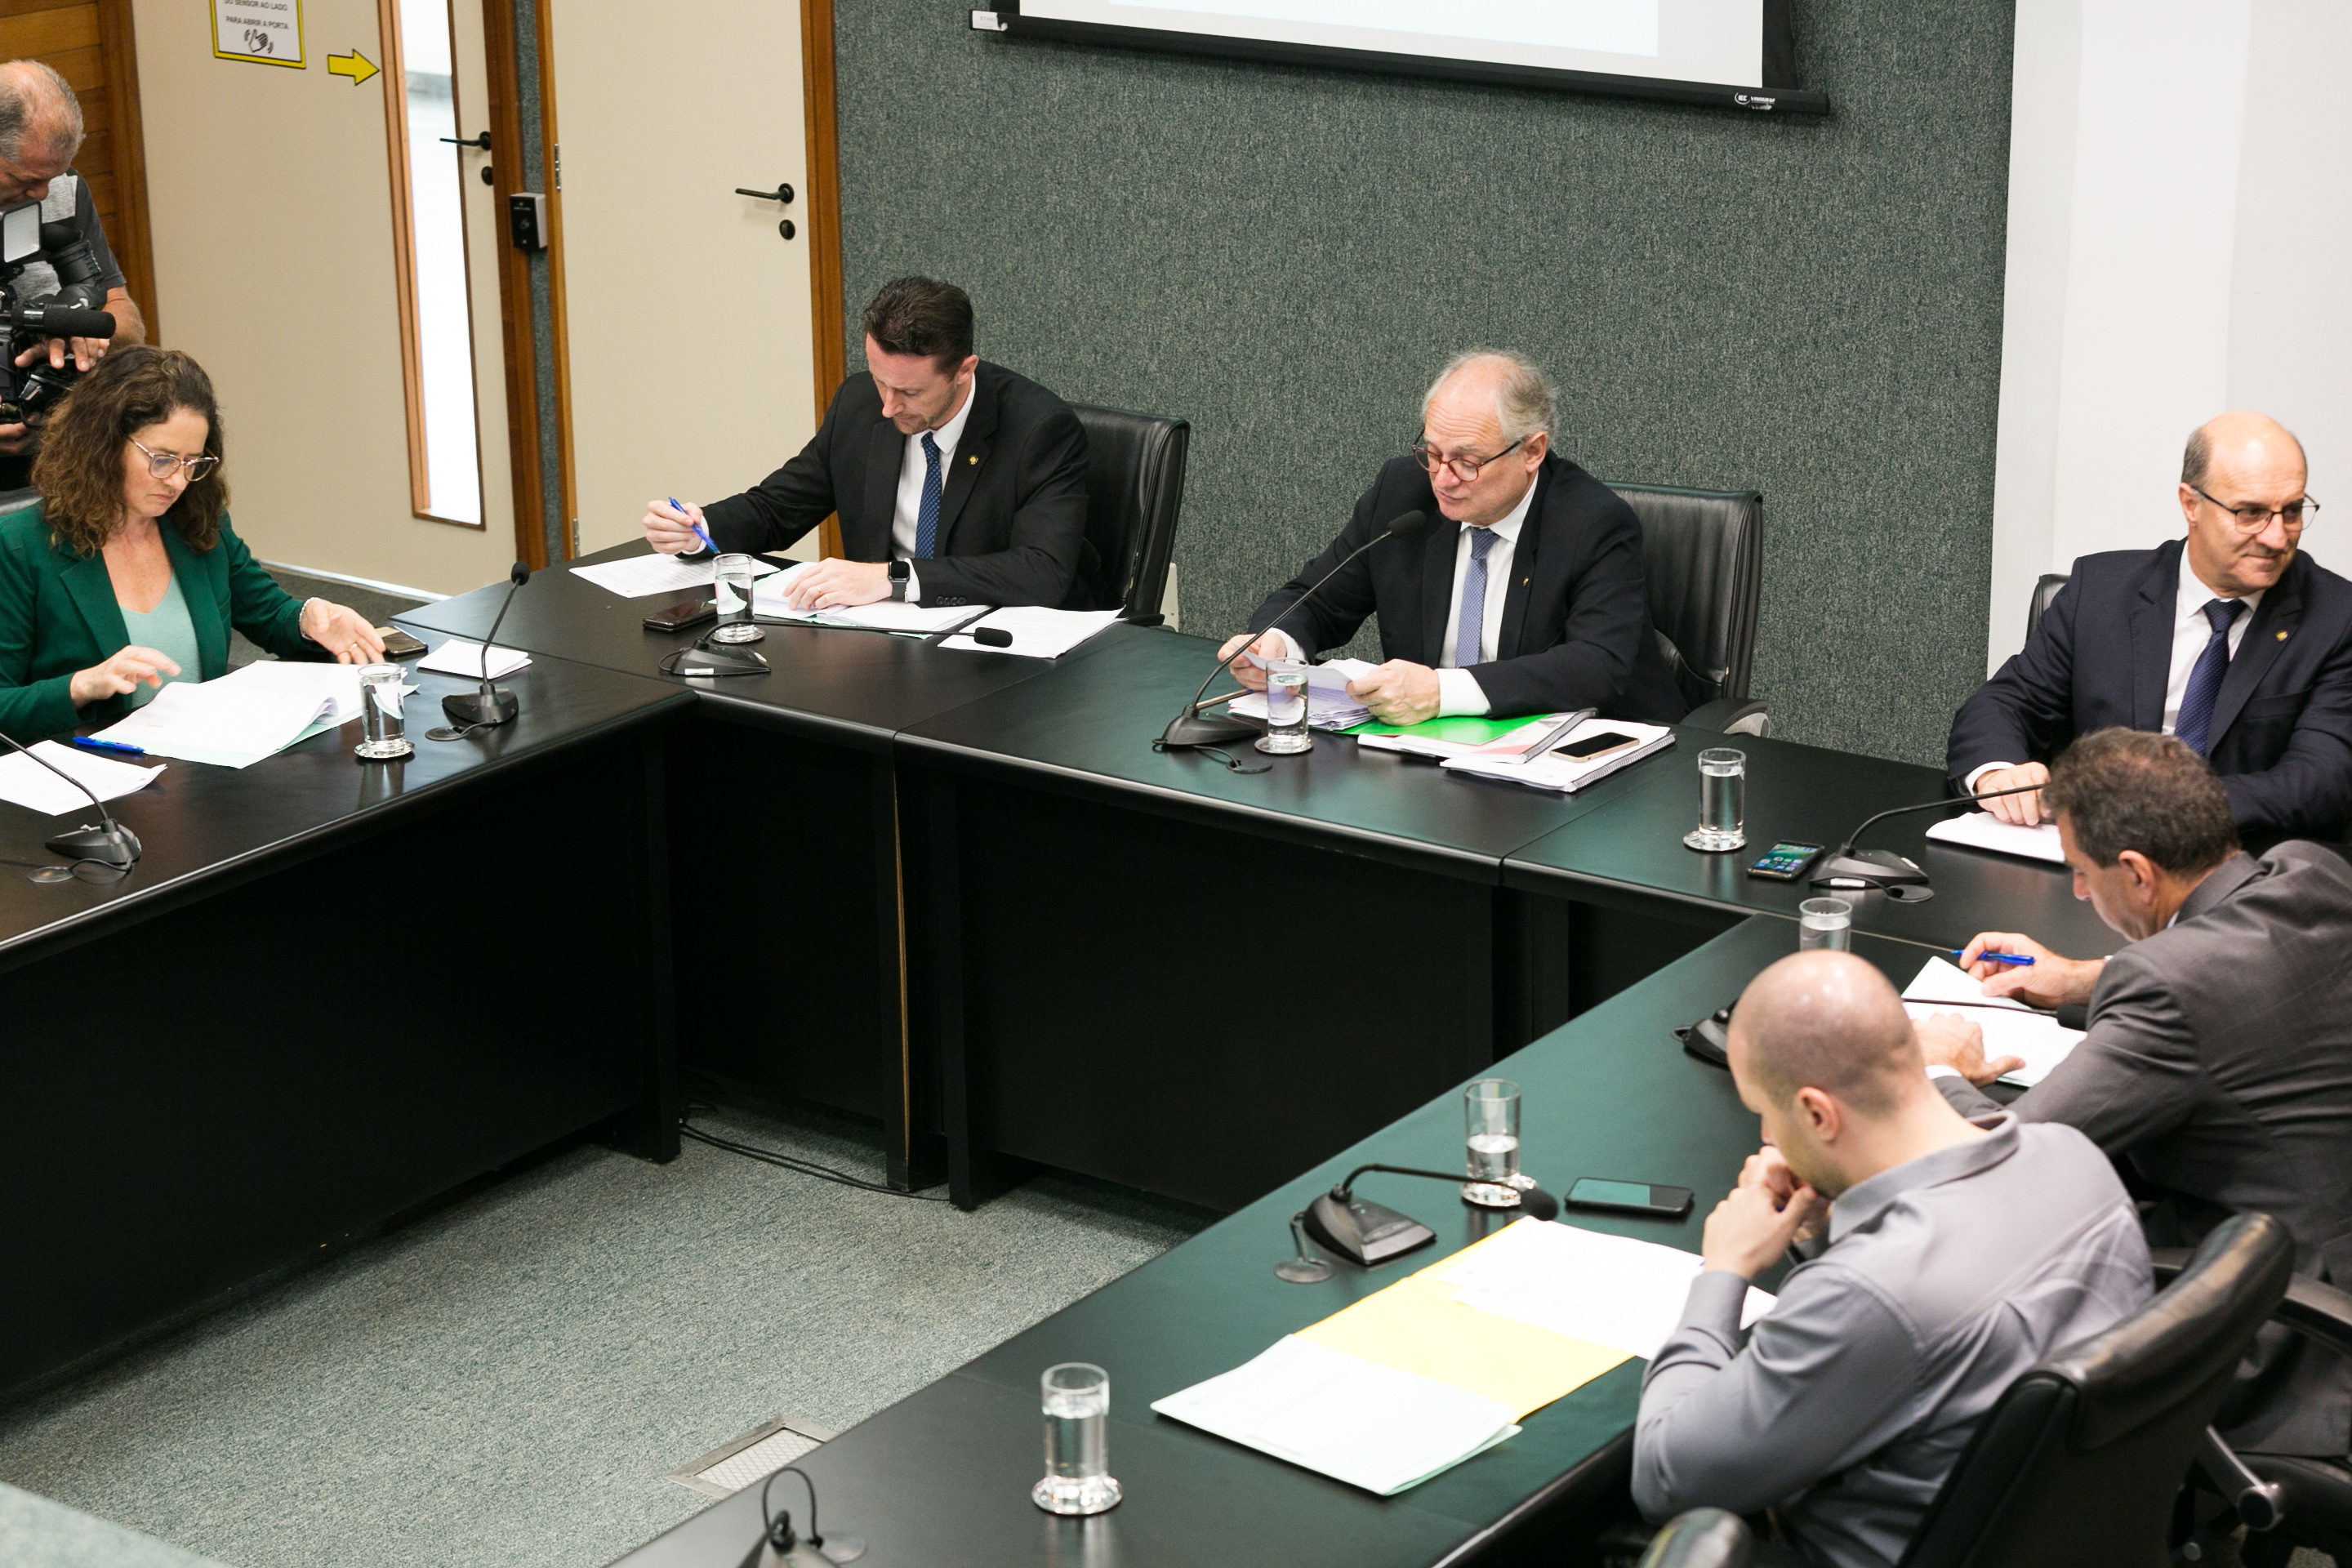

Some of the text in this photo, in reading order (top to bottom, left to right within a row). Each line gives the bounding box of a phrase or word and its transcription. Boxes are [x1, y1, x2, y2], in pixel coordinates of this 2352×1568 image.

[271, 2, 288, 11] LADO
[225, 16, 242, 24] PARA
[269, 21, 289, 29] PORTA
